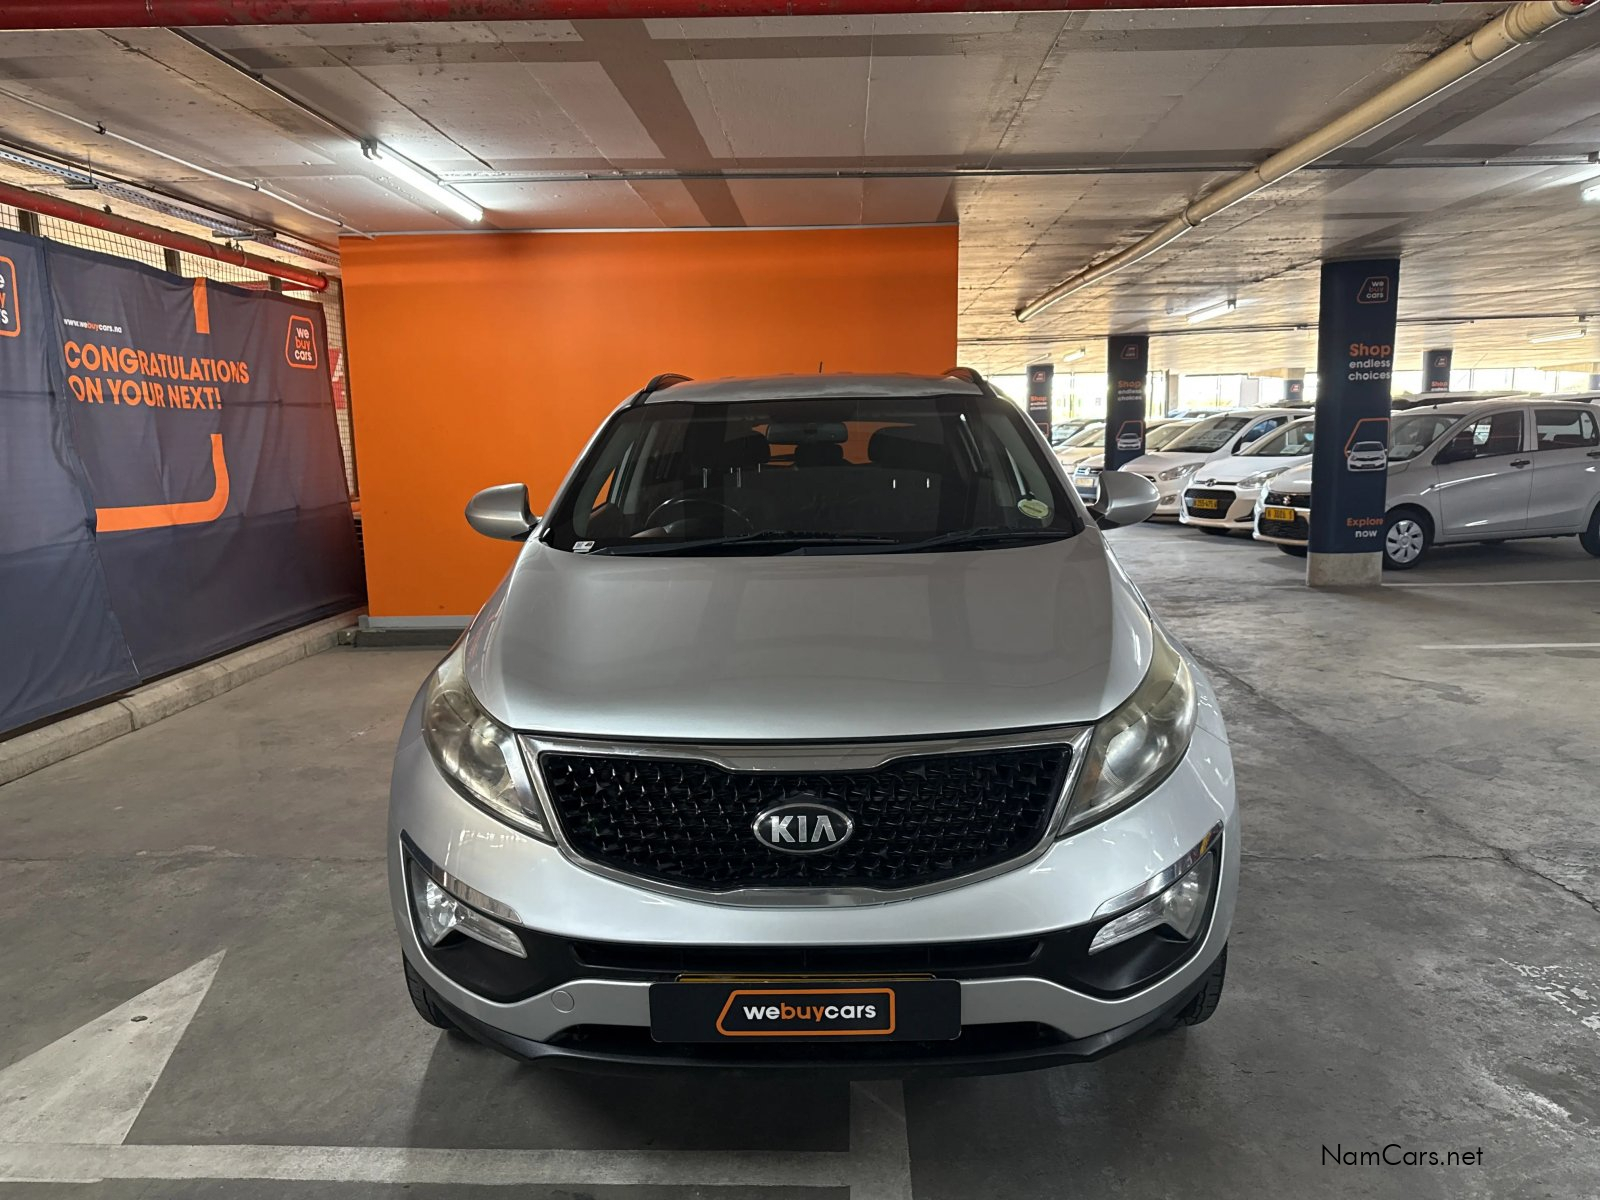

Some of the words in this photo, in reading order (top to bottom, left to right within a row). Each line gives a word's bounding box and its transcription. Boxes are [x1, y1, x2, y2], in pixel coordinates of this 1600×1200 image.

[296, 327, 310, 339] we
[295, 336, 311, 351] buy
[1349, 343, 1391, 357] Shop
[64, 340, 250, 384] CONGRATULATIONS
[294, 350, 312, 362] cars
[1349, 359, 1391, 369] endless
[1348, 371, 1391, 381] choices
[68, 375, 104, 404] ON
[106, 378, 166, 408] YOUR
[167, 385, 223, 410] NEXT!
[1355, 530, 1378, 538] now
[770, 815, 837, 843] KIA
[742, 1002, 877, 1022] webuycars
